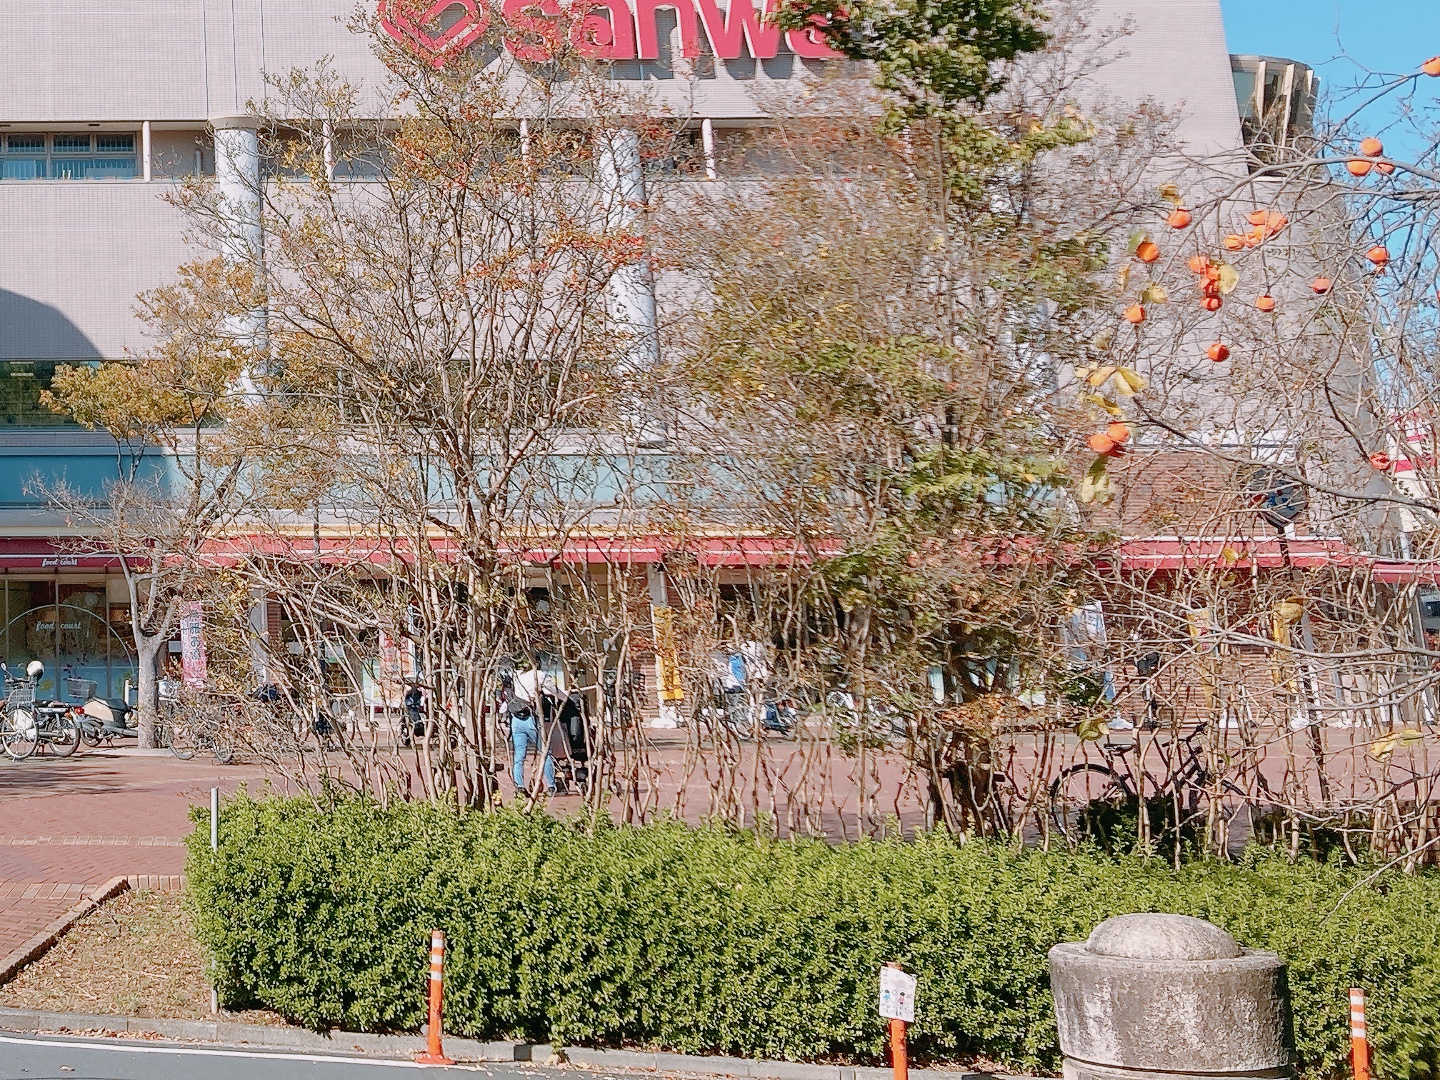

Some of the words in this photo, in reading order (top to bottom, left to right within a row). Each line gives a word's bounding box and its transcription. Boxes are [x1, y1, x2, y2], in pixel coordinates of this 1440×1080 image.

[41, 558, 58, 567] food
[59, 558, 78, 566] court
[36, 620, 56, 632] food
[60, 621, 82, 630] court
